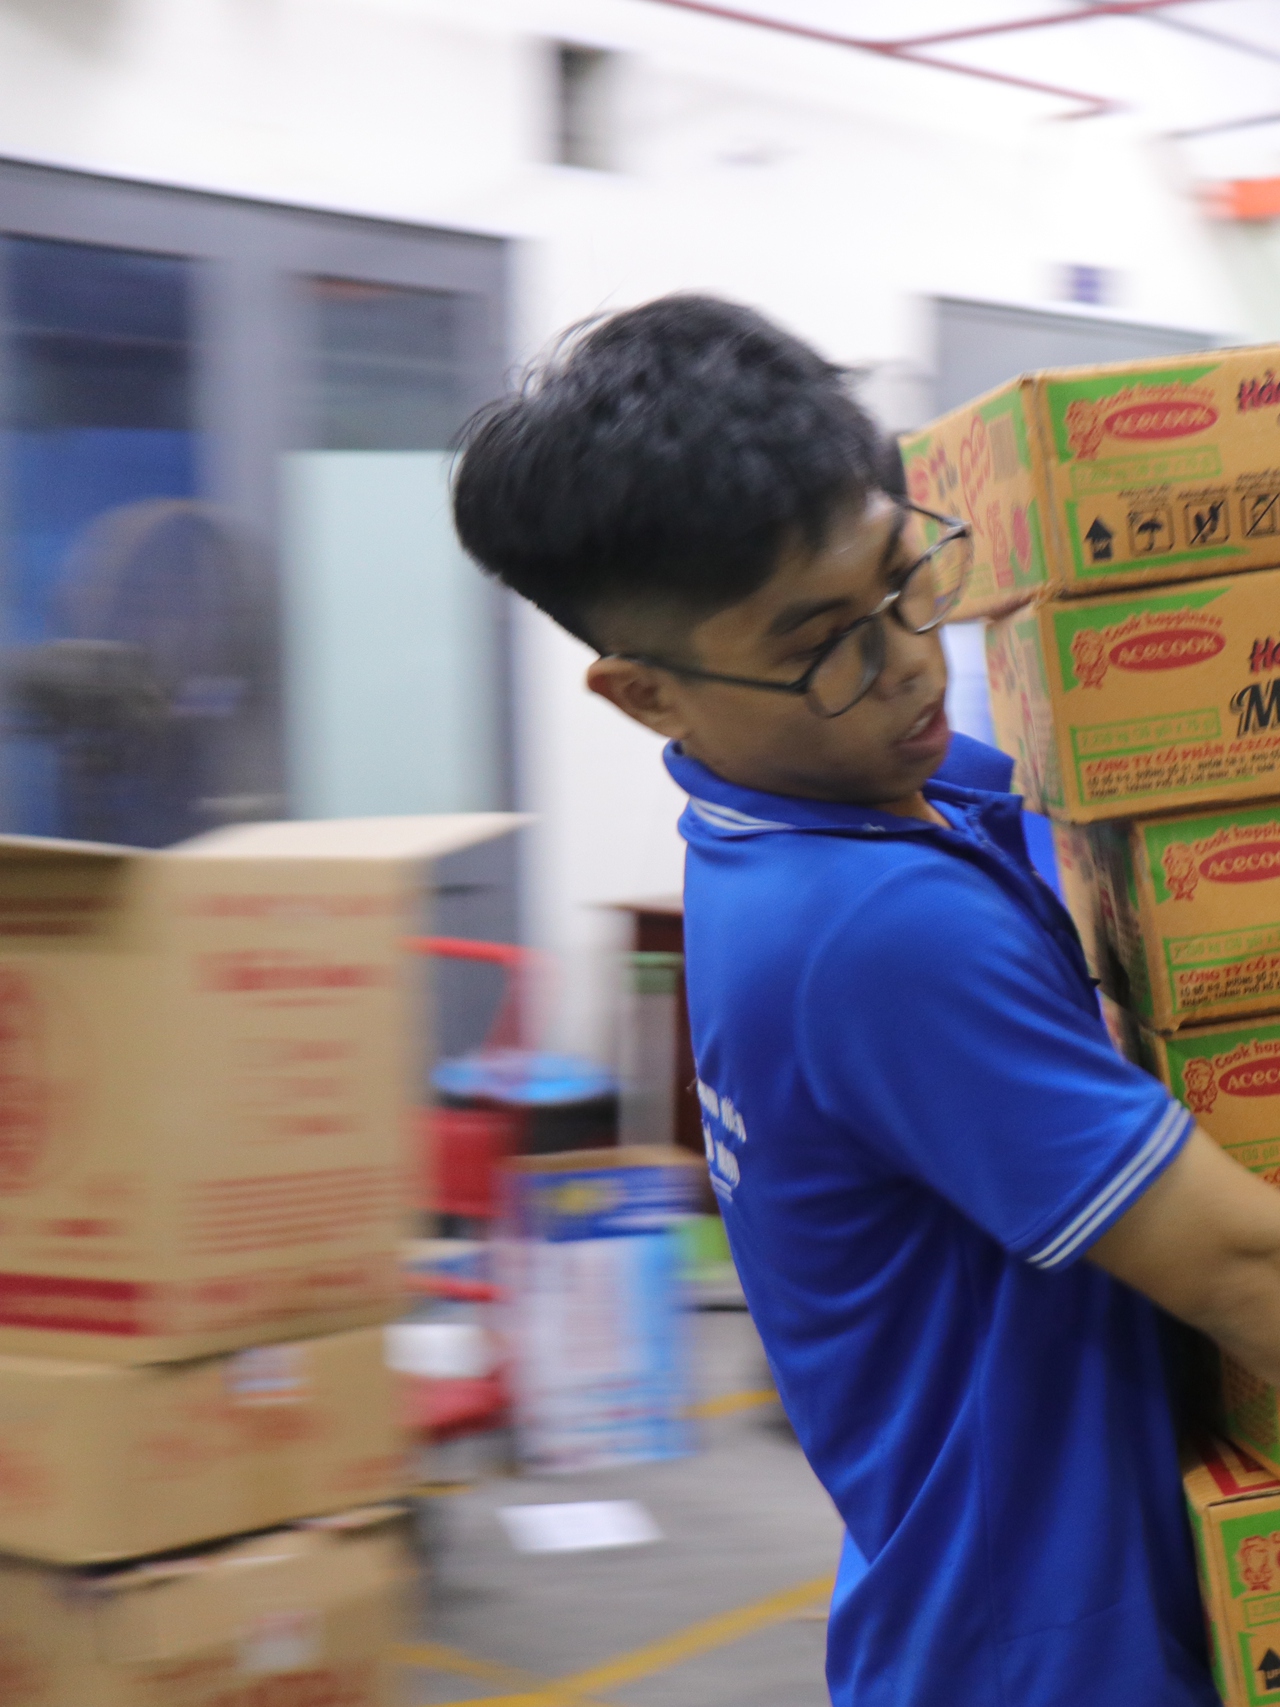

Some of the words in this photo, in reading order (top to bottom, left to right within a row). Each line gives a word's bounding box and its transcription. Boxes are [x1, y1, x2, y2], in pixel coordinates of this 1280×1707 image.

[1179, 969, 1220, 985] CÔNG
[1224, 965, 1242, 978] TY
[1214, 1043, 1250, 1069] Cook
